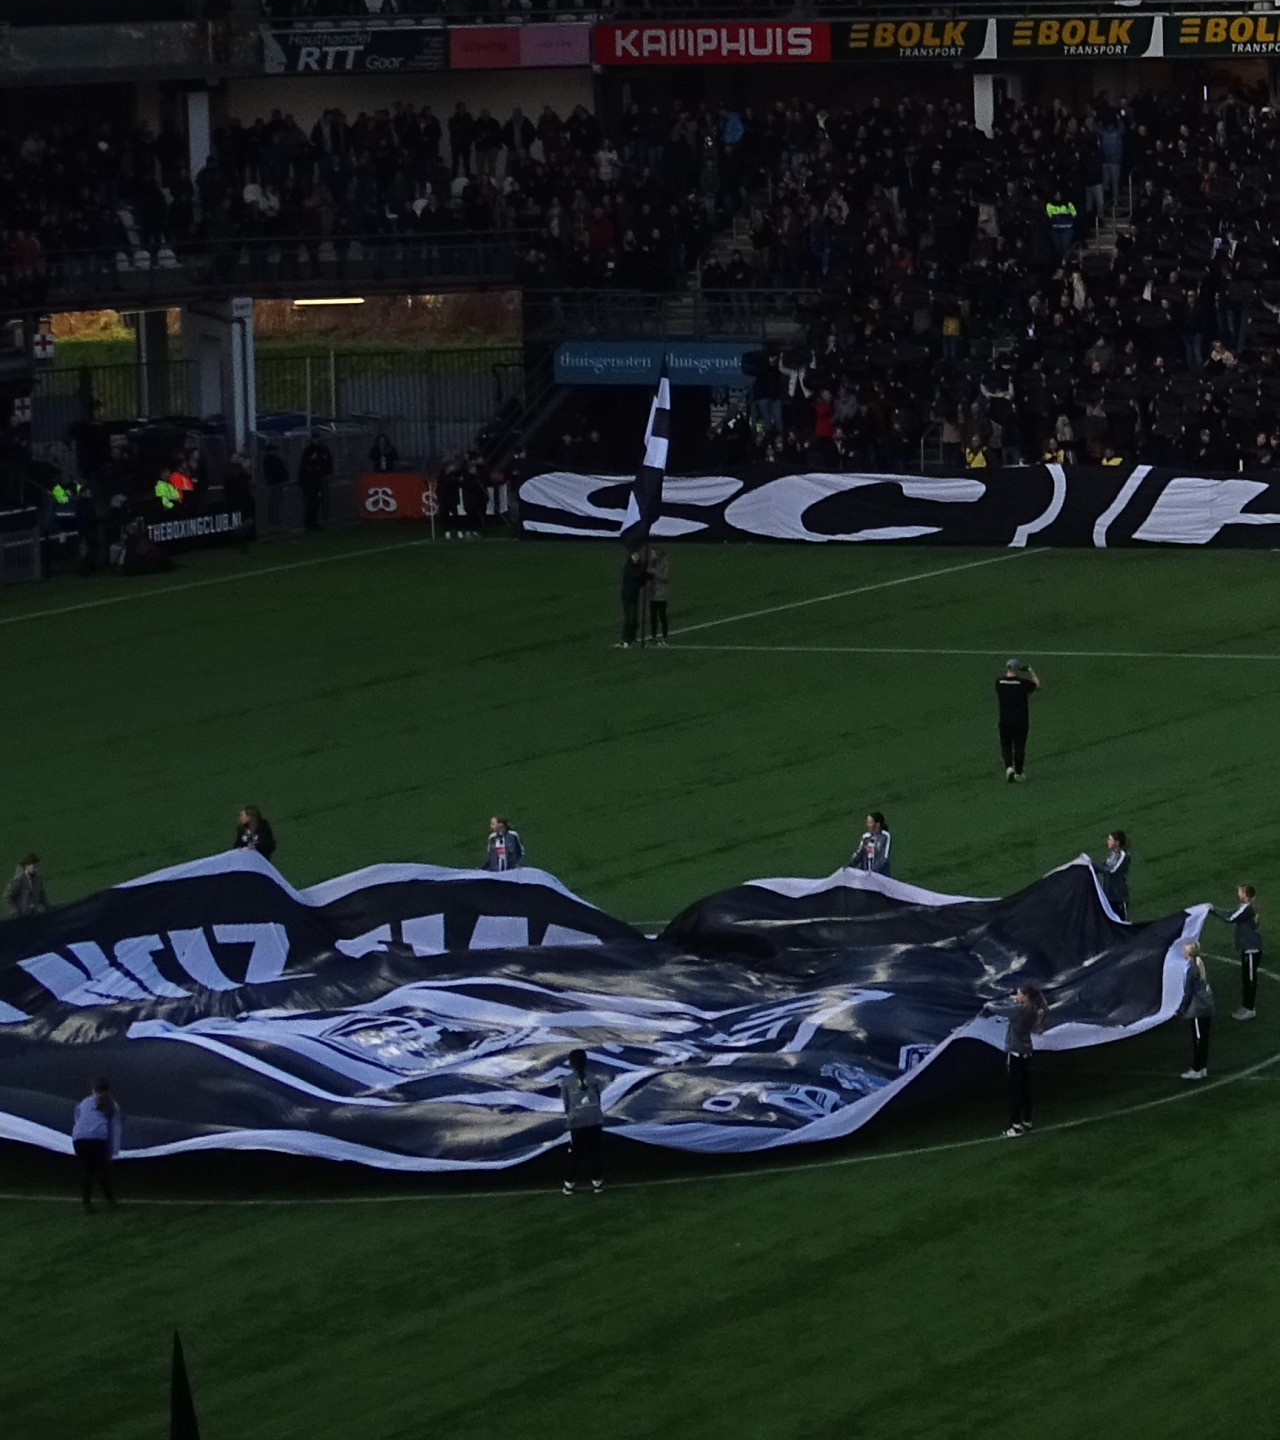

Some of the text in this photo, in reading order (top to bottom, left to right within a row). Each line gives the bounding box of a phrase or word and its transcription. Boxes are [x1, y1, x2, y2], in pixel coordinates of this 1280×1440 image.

[288, 30, 372, 47] Houthandel
[614, 27, 814, 58] KAMPHUIS
[873, 21, 968, 47] BOLK
[1037, 18, 1135, 46] BOLK
[297, 44, 365, 71] RTT
[899, 47, 964, 58] TRANSPORT
[1063, 45, 1129, 56] TRANSPORT
[518, 470, 987, 543] SC
